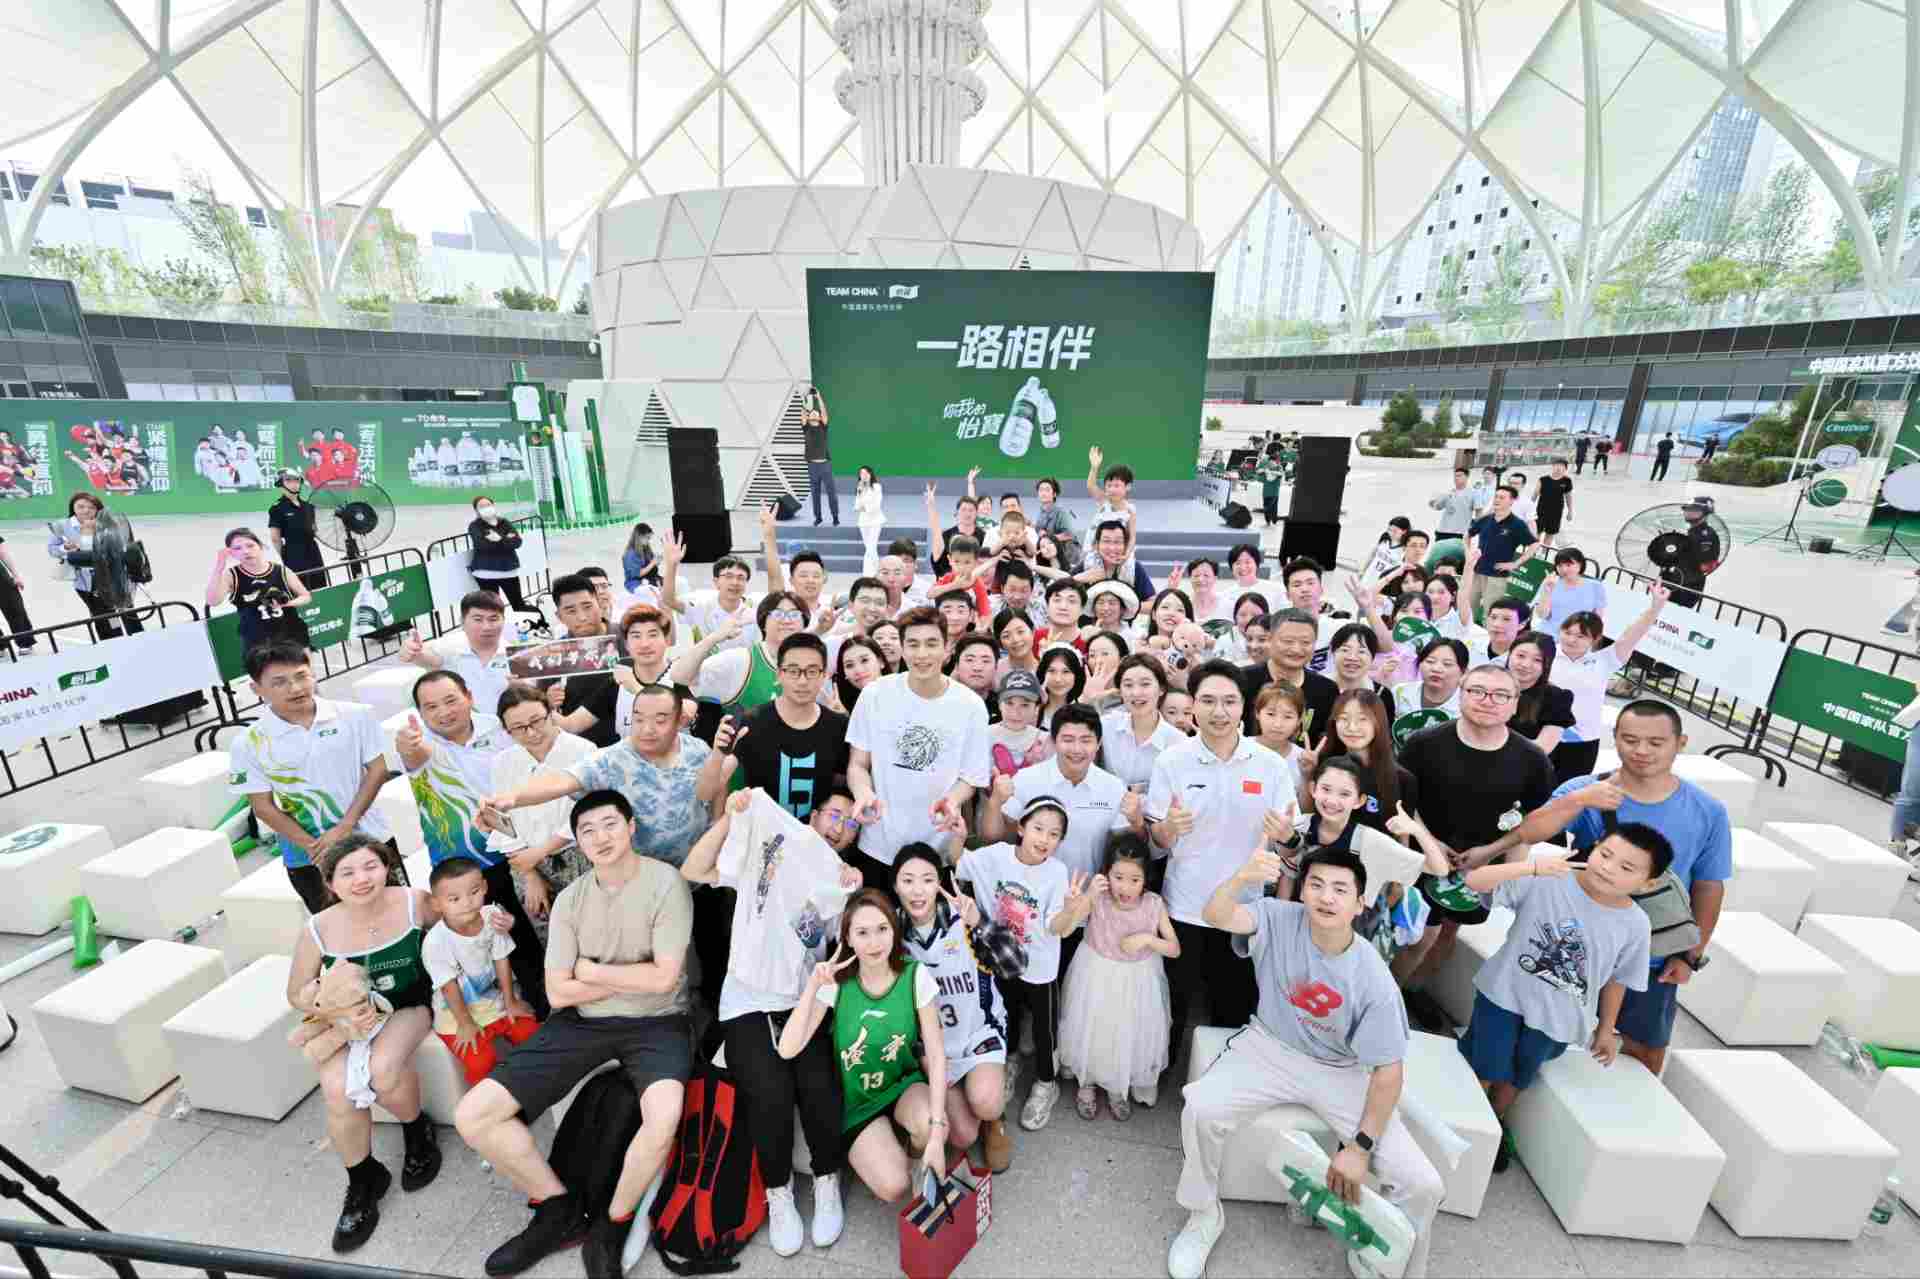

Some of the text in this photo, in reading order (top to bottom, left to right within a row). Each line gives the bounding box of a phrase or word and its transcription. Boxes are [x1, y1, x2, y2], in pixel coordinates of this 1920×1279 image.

[825, 287, 879, 296] TEAM CHINA
[916, 324, 1096, 370] 一路相伴
[860, 1071, 884, 1090] 13
